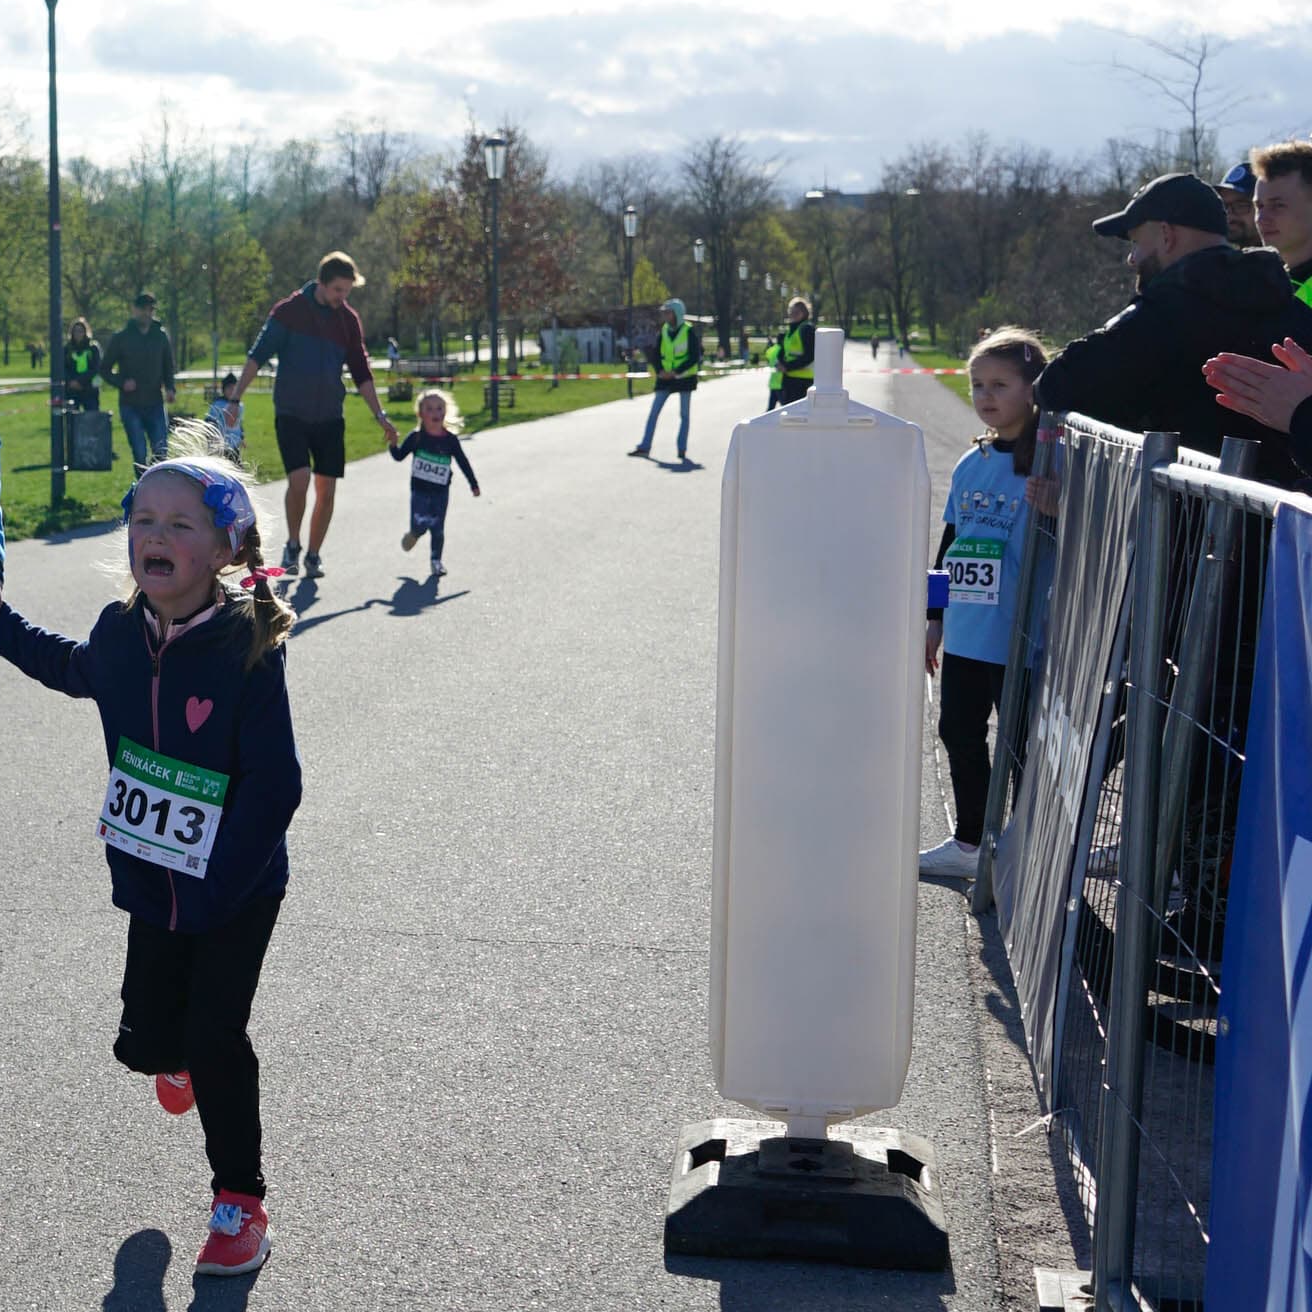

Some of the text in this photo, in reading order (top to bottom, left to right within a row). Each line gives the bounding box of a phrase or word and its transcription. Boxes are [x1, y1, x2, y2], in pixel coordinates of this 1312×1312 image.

[415, 459, 447, 477] 3042
[946, 561, 994, 587] 3053
[121, 747, 171, 781] FÉNIXÁČEK
[109, 779, 206, 846] 3013
